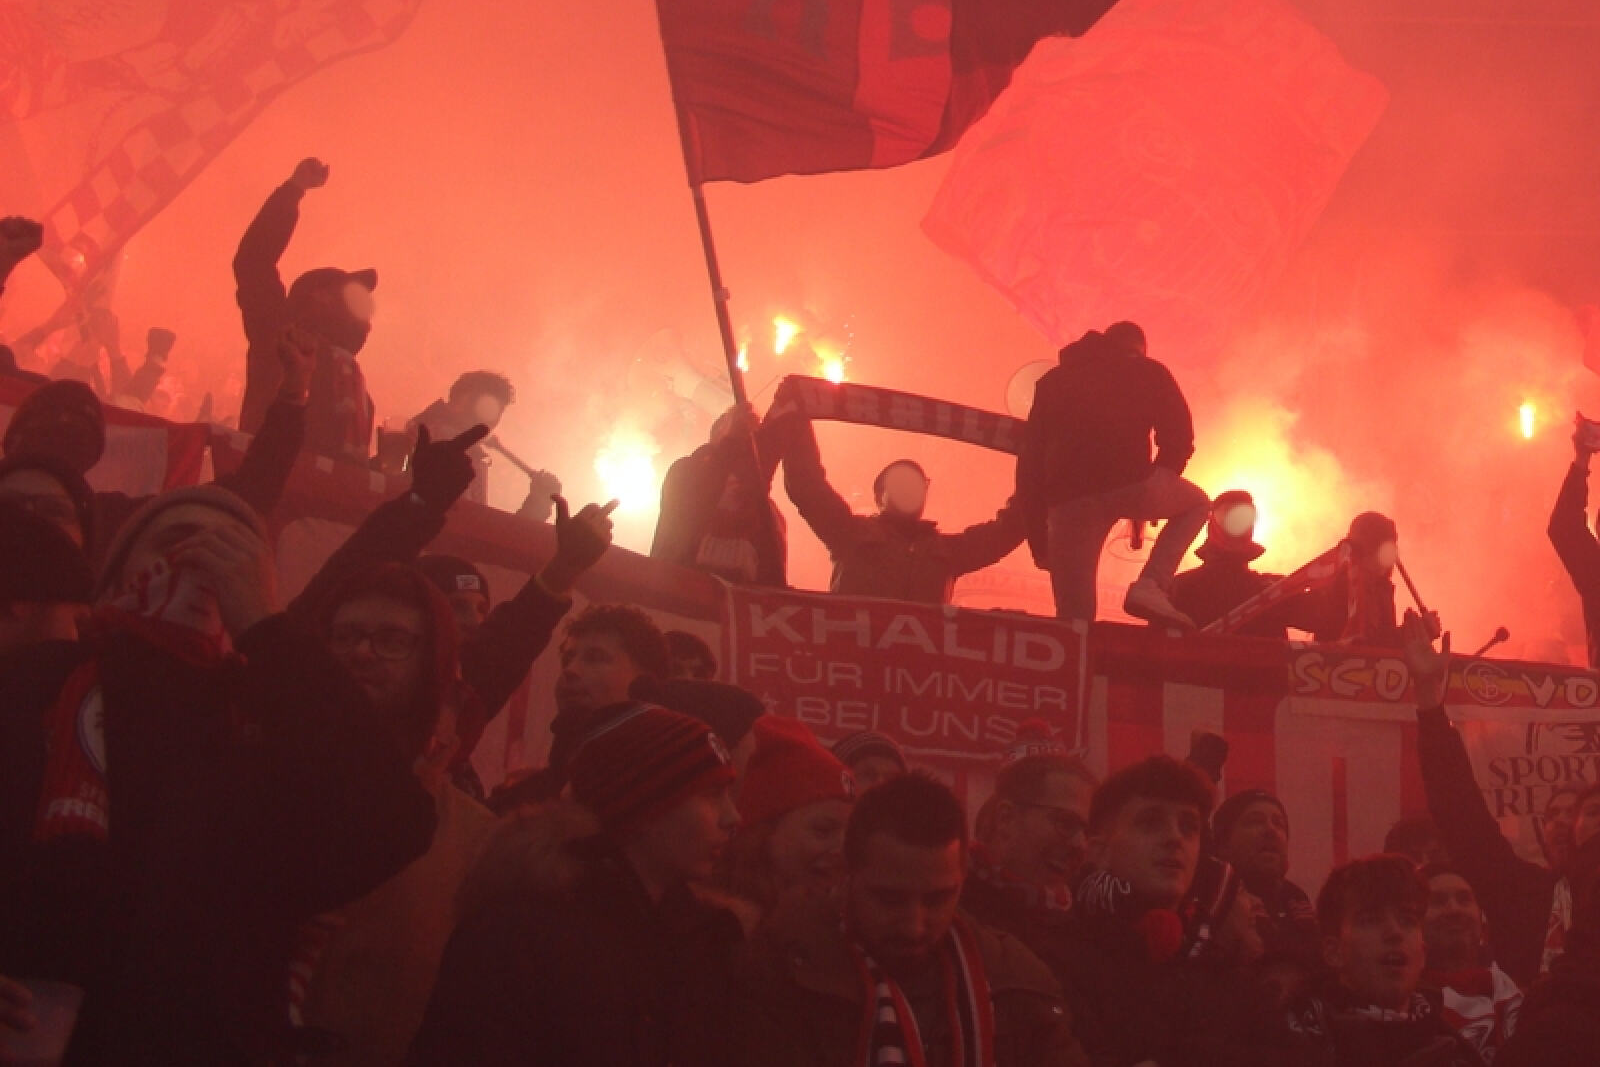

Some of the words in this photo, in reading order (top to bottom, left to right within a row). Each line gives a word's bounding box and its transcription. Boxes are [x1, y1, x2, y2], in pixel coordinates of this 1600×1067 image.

[749, 604, 1065, 672] KHALID
[749, 651, 863, 689] FÜR
[884, 666, 1067, 711] IMMER
[796, 695, 880, 731] BEI
[901, 707, 1019, 742] UNS
